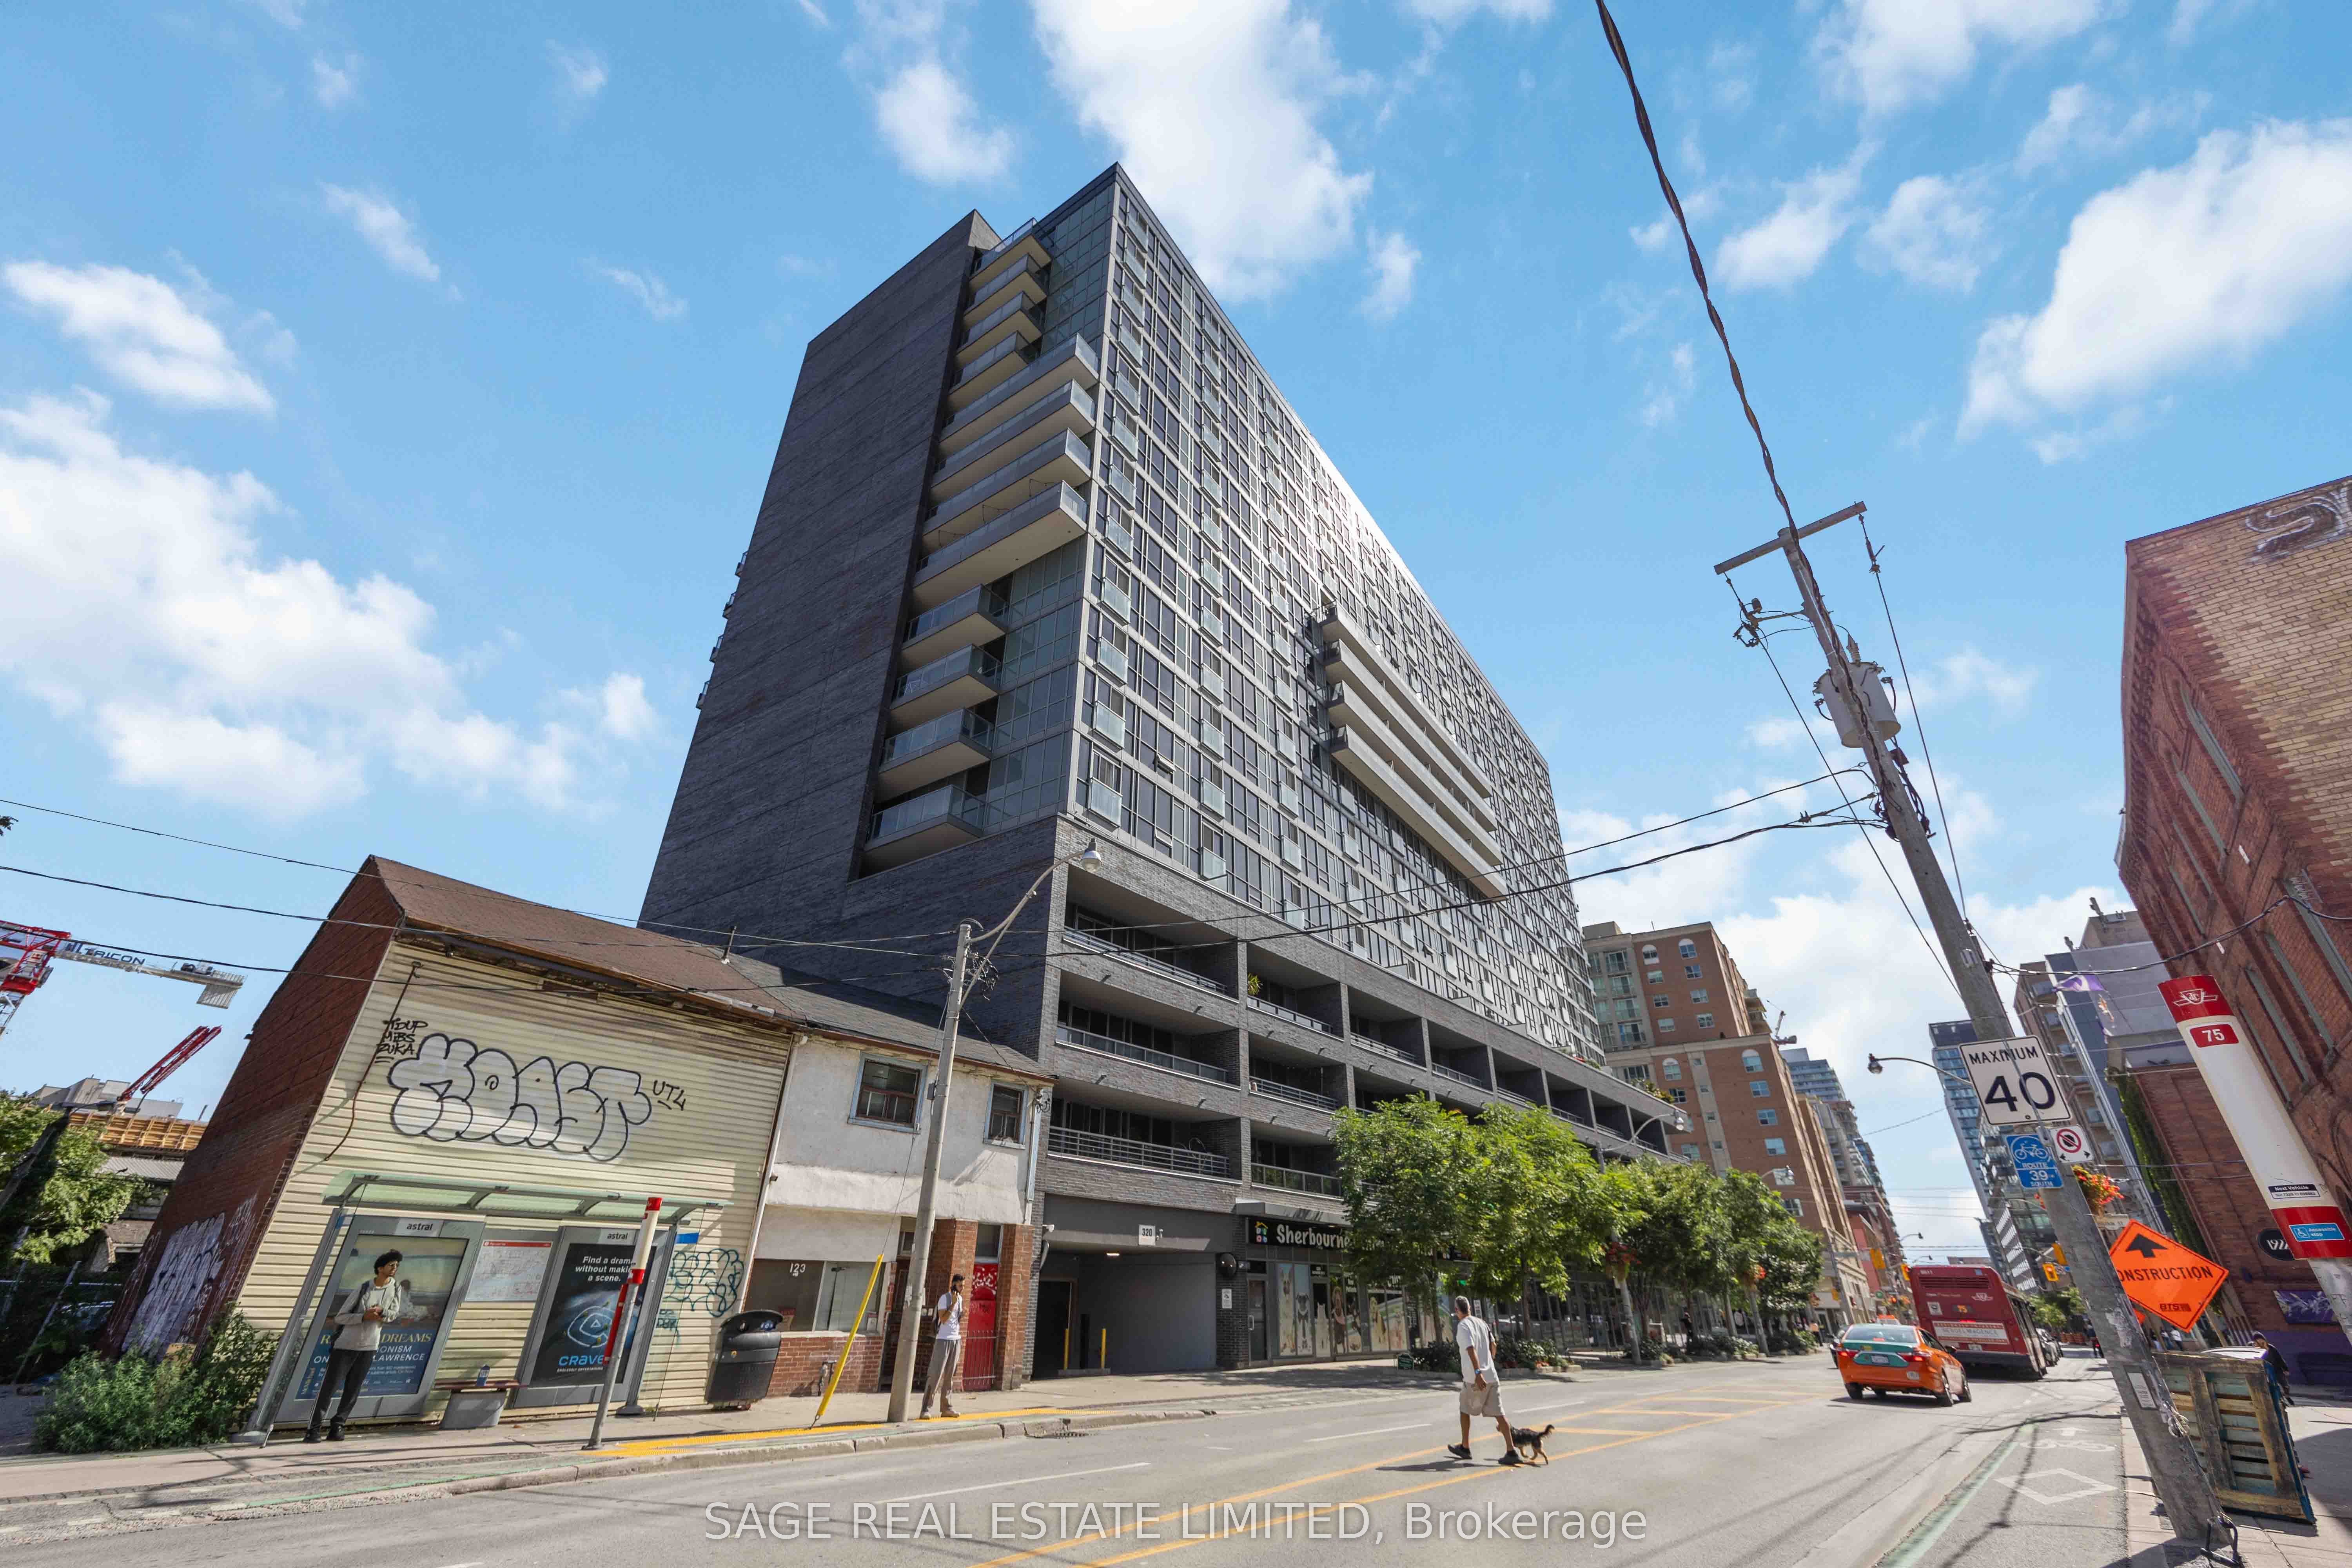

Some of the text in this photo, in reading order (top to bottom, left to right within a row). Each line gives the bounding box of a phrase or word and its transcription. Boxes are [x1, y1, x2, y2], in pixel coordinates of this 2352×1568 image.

[2201, 1029, 2225, 1042] 75
[1968, 1046, 2038, 1065] MAXIMUM
[1985, 1072, 2056, 1112] 40
[2029, 1170, 2048, 1181] 39
[407, 1223, 433, 1231] astral
[1142, 1228, 1152, 1237] 320
[1276, 1223, 1349, 1249] Sherbourne
[790, 1262, 806, 1273] 123
[2116, 1266, 2214, 1282] ONSTRUCTION
[381, 1334, 432, 1343] DREAMS
[372, 1354, 426, 1362] LAWRENCE
